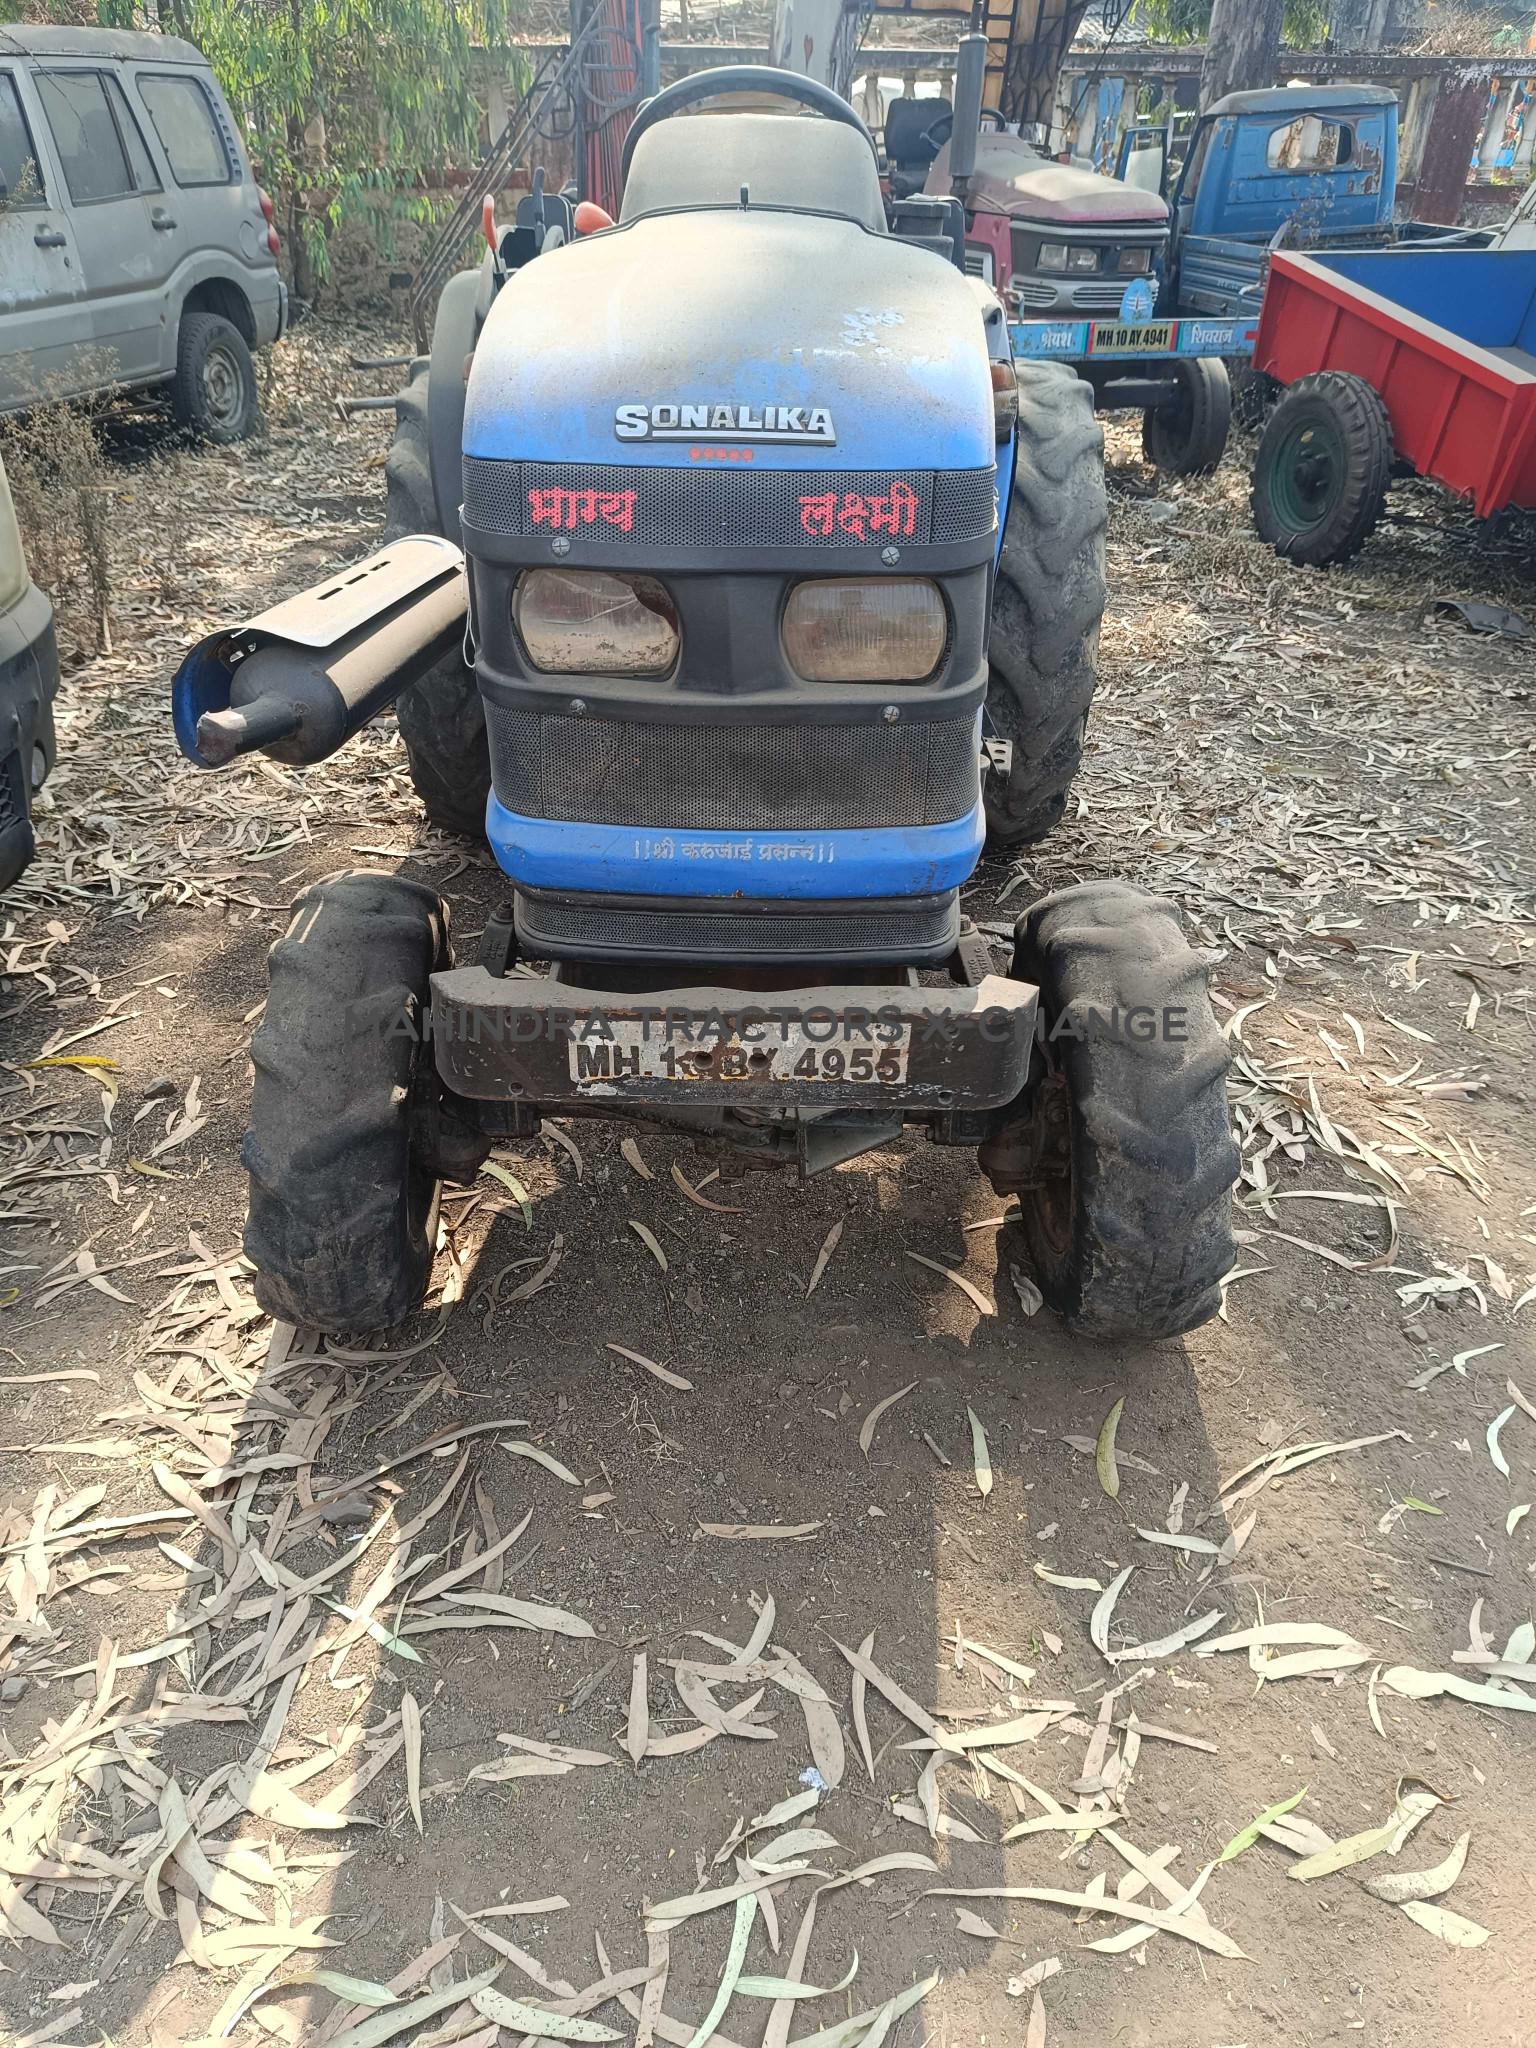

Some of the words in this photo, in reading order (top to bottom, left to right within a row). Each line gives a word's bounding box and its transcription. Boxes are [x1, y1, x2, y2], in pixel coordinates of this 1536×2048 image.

[1190, 324, 1234, 344] शिवराज
[615, 404, 834, 441] SONALIKA
[528, 486, 638, 532] भाग्य
[798, 481, 920, 541] लक्ष्मी
